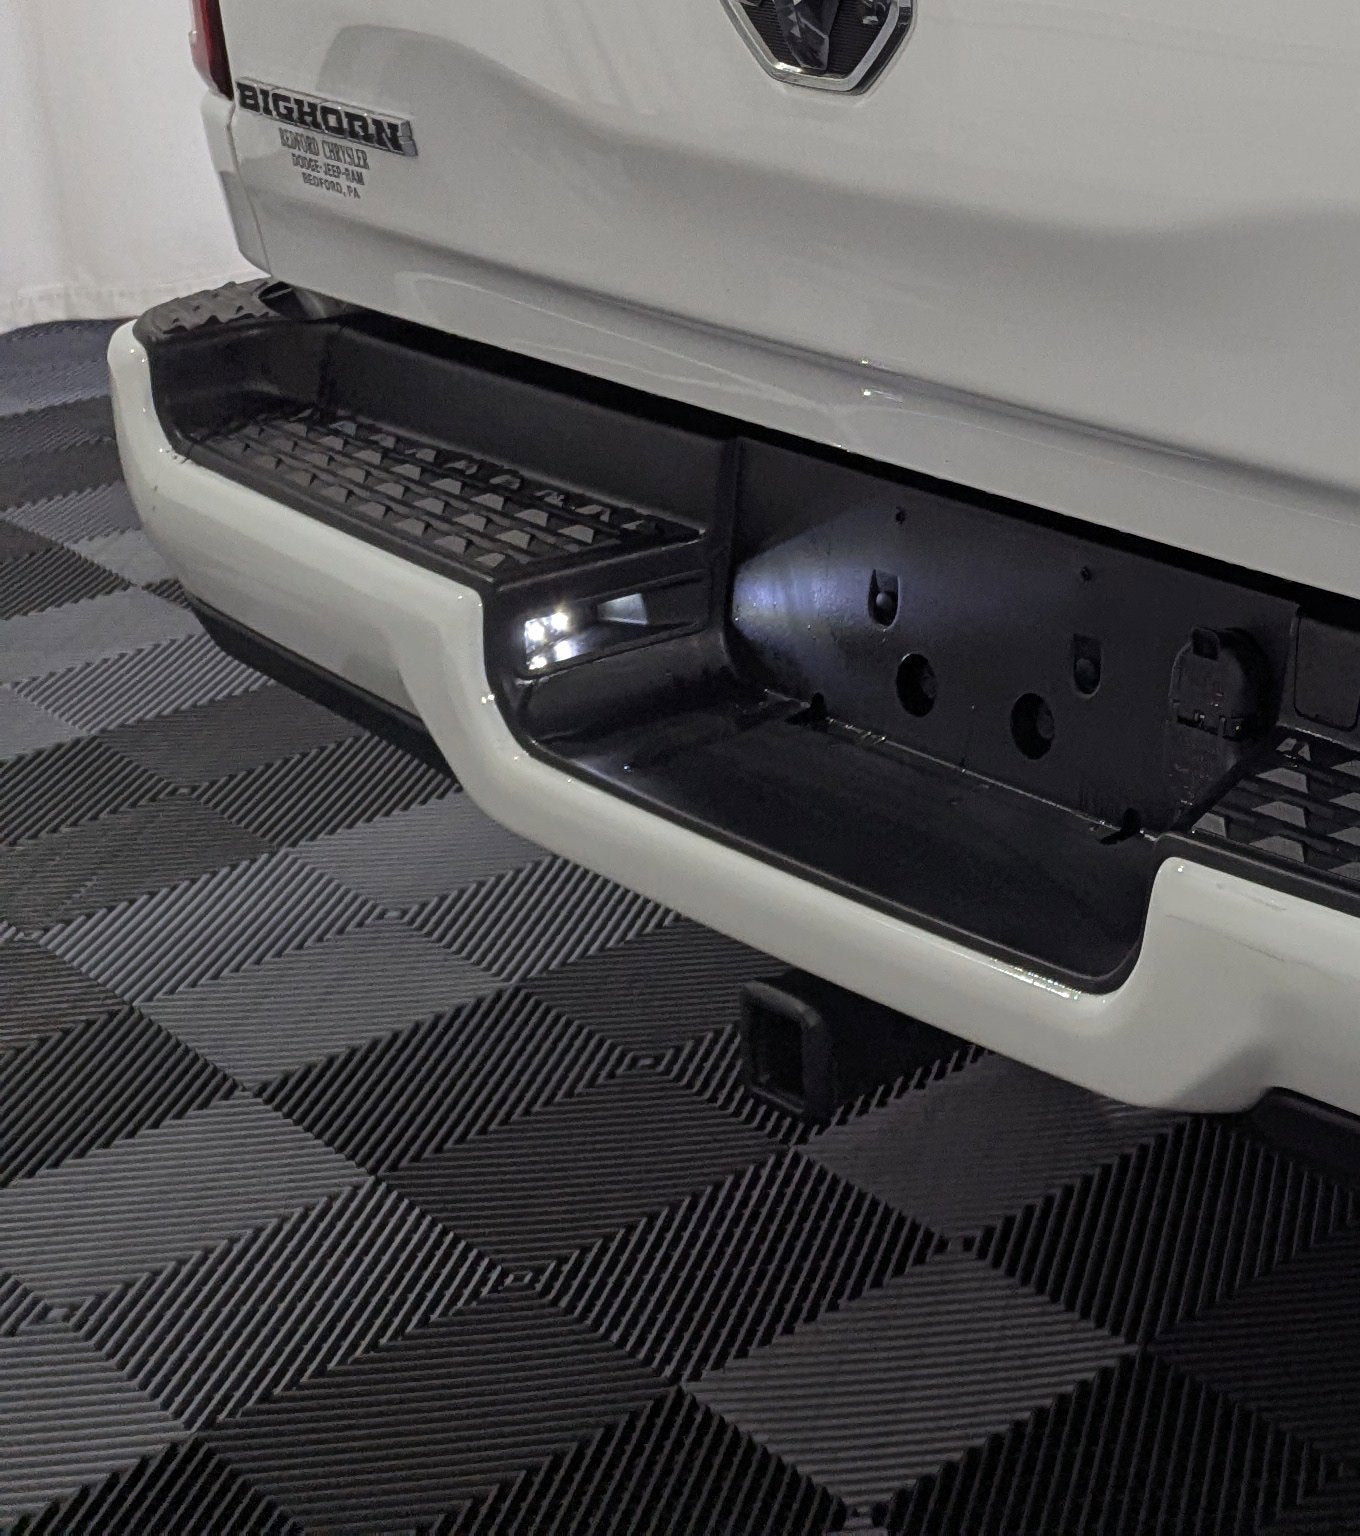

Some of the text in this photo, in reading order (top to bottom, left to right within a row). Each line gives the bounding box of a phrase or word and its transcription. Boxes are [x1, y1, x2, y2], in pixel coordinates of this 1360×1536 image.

[235, 80, 405, 154] BIGHORN
[321, 140, 370, 170] CHRYSLER
[347, 185, 361, 200] PA
